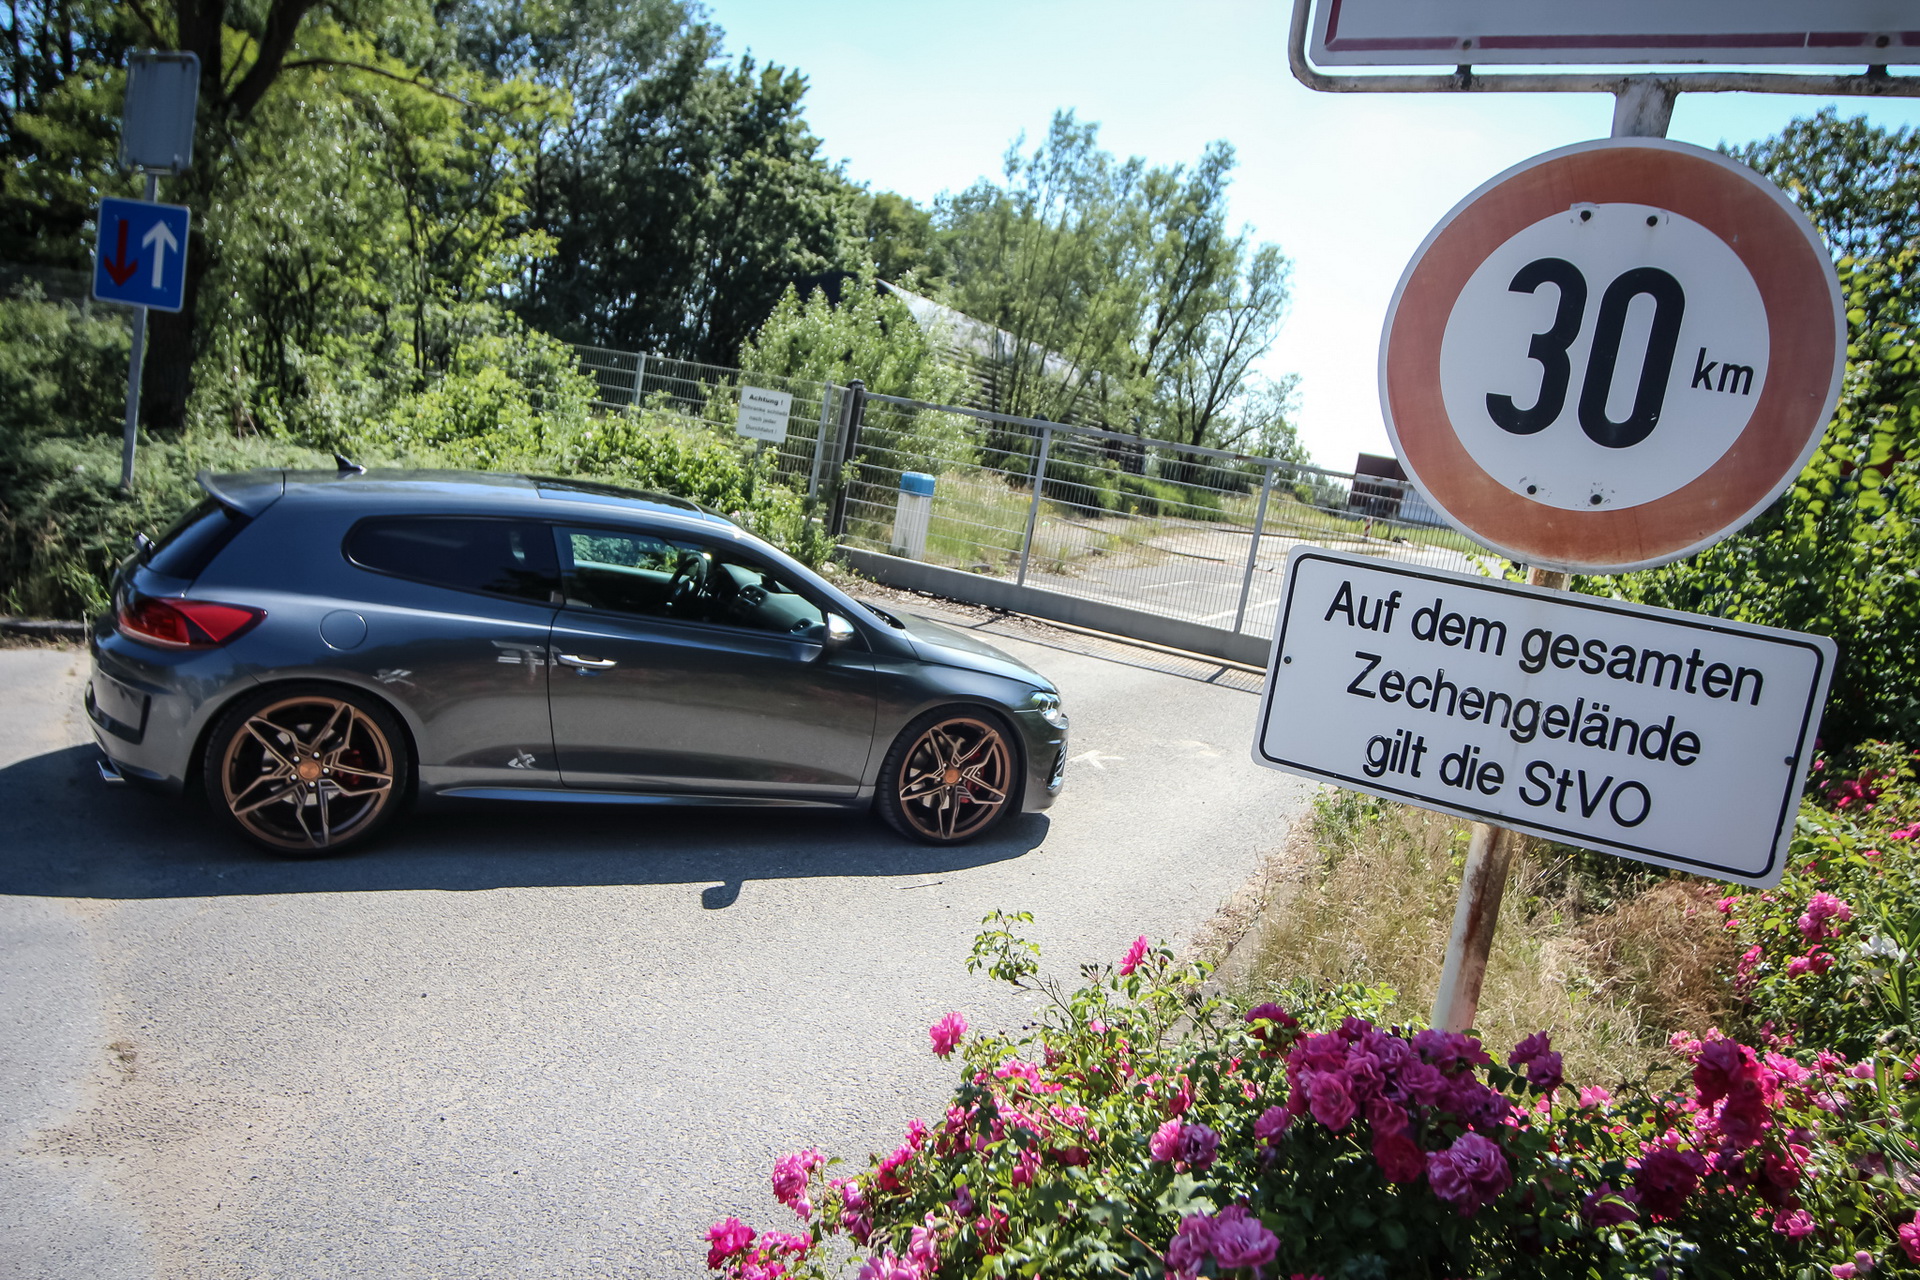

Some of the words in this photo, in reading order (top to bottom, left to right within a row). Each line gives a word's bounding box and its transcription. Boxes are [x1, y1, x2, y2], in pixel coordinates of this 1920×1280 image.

[749, 394, 779, 406] Achtung
[1485, 257, 1686, 449] 30
[1690, 347, 1755, 396] km
[1324, 581, 1402, 633] Auf
[1411, 598, 1507, 656] dem
[1520, 627, 1764, 705] gesamten
[1347, 651, 1702, 766] Zechengelände
[1363, 728, 1427, 777] gilt
[1439, 744, 1504, 795] die
[1518, 760, 1652, 827] StVO
